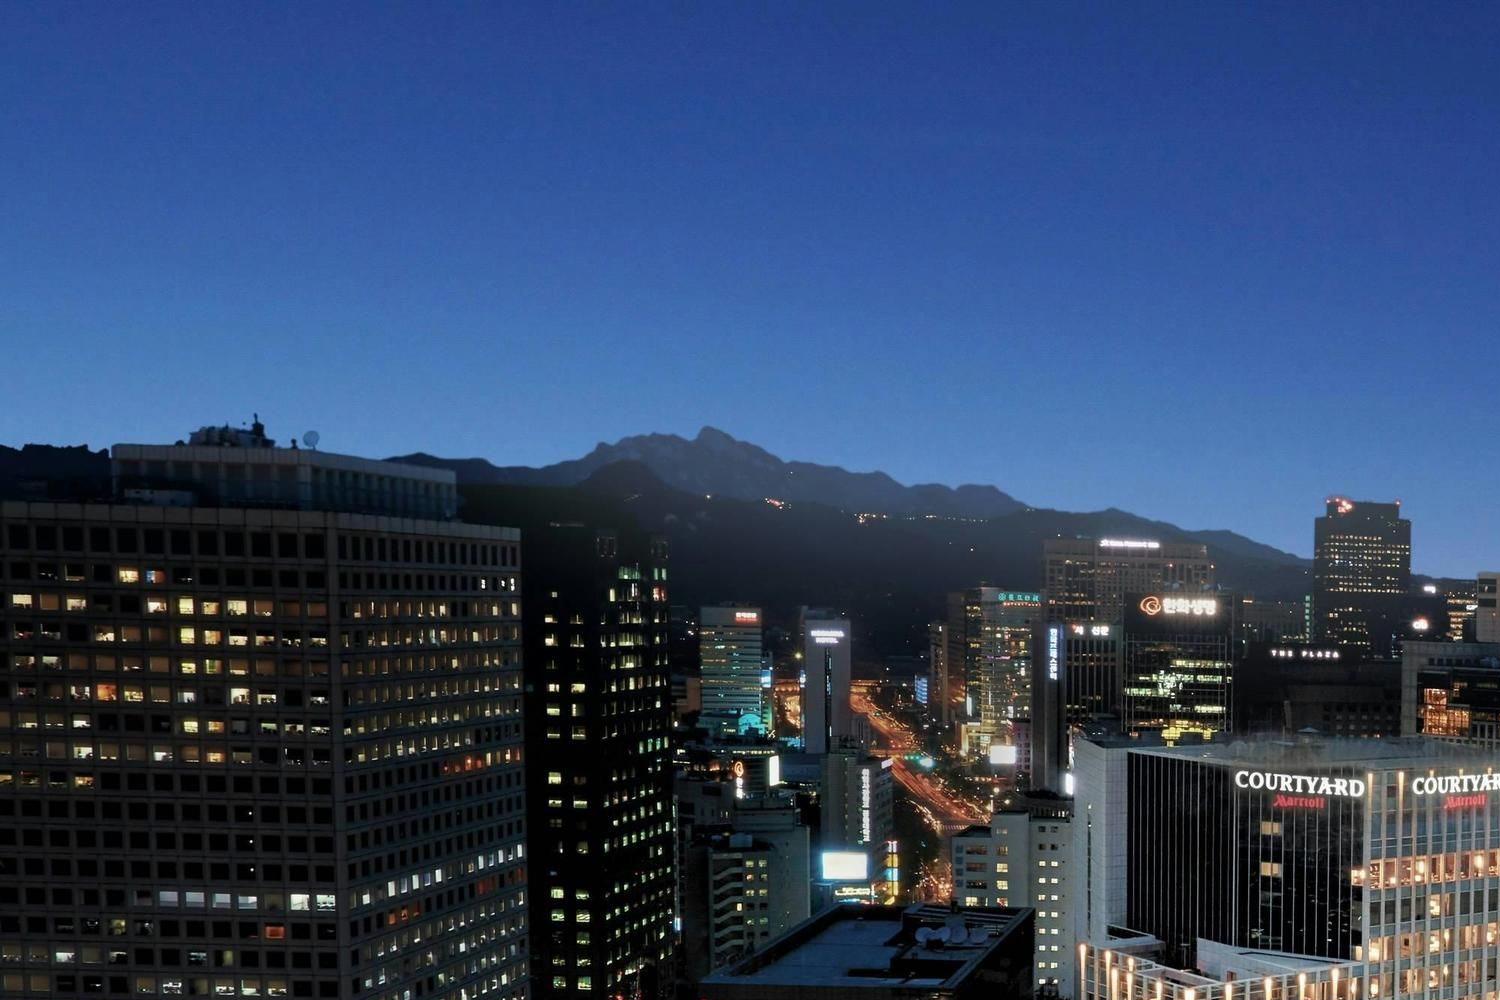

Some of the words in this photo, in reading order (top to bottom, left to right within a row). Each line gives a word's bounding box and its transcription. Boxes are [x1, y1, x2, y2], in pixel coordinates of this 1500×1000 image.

[1162, 598, 1217, 615] 한화생명
[1271, 649, 1294, 658] THE
[1301, 649, 1341, 658] PLAZA
[1235, 770, 1365, 798] COURTYARD
[1272, 794, 1326, 810] Marriott
[1443, 794, 1488, 810] Marriott
